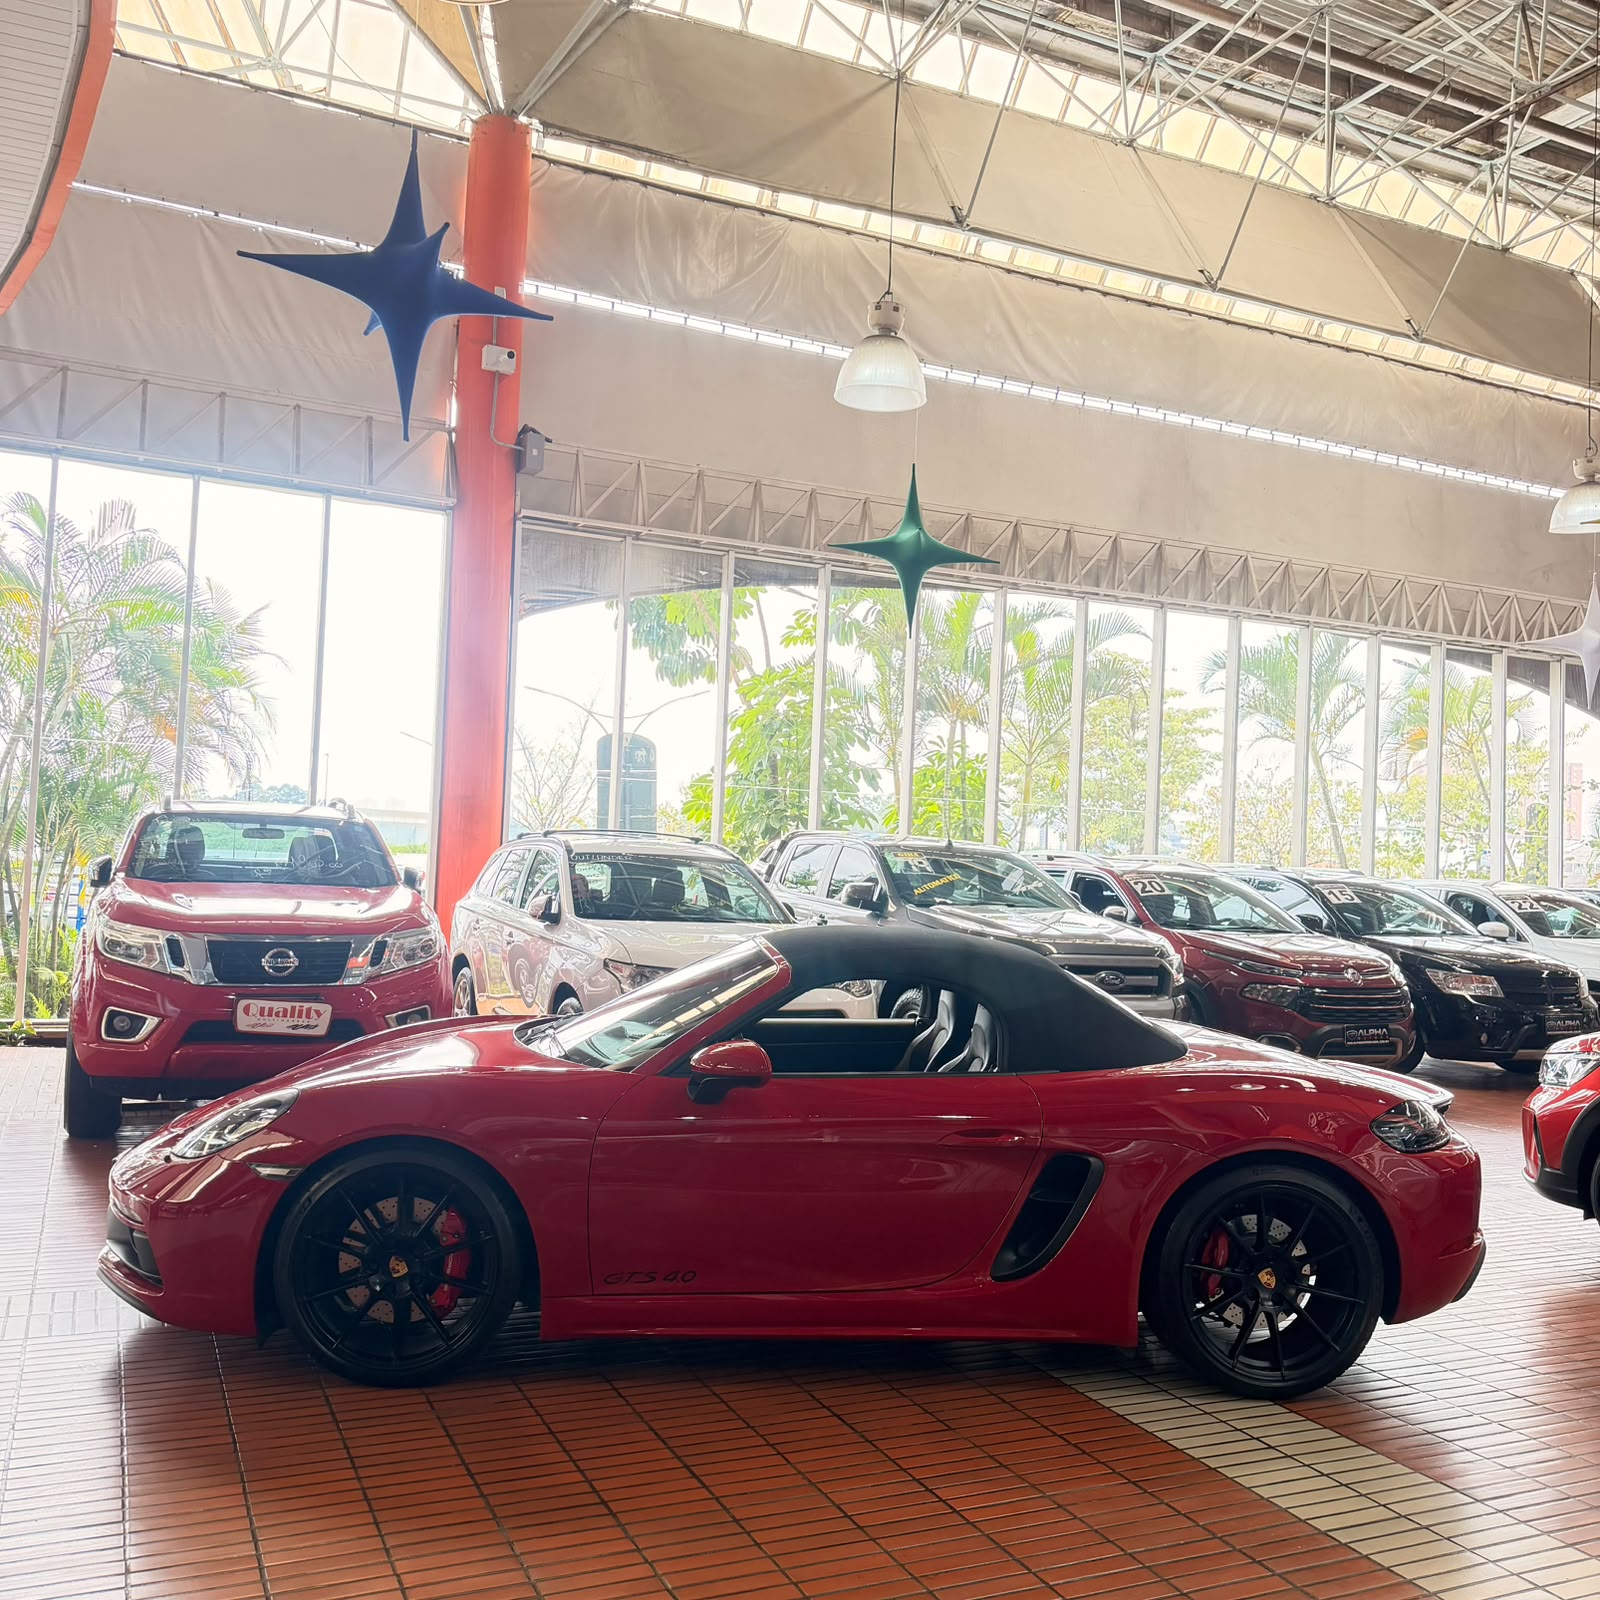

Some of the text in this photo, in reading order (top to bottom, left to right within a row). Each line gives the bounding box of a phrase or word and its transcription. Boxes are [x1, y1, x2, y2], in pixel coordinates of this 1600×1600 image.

[1133, 880, 1166, 894] 20
[1327, 890, 1355, 902] 15
[1510, 900, 1540, 910] 22
[243, 1002, 327, 1021] Quality
[1358, 1028, 1388, 1037] ALPHA
[603, 1271, 658, 1285] GTS
